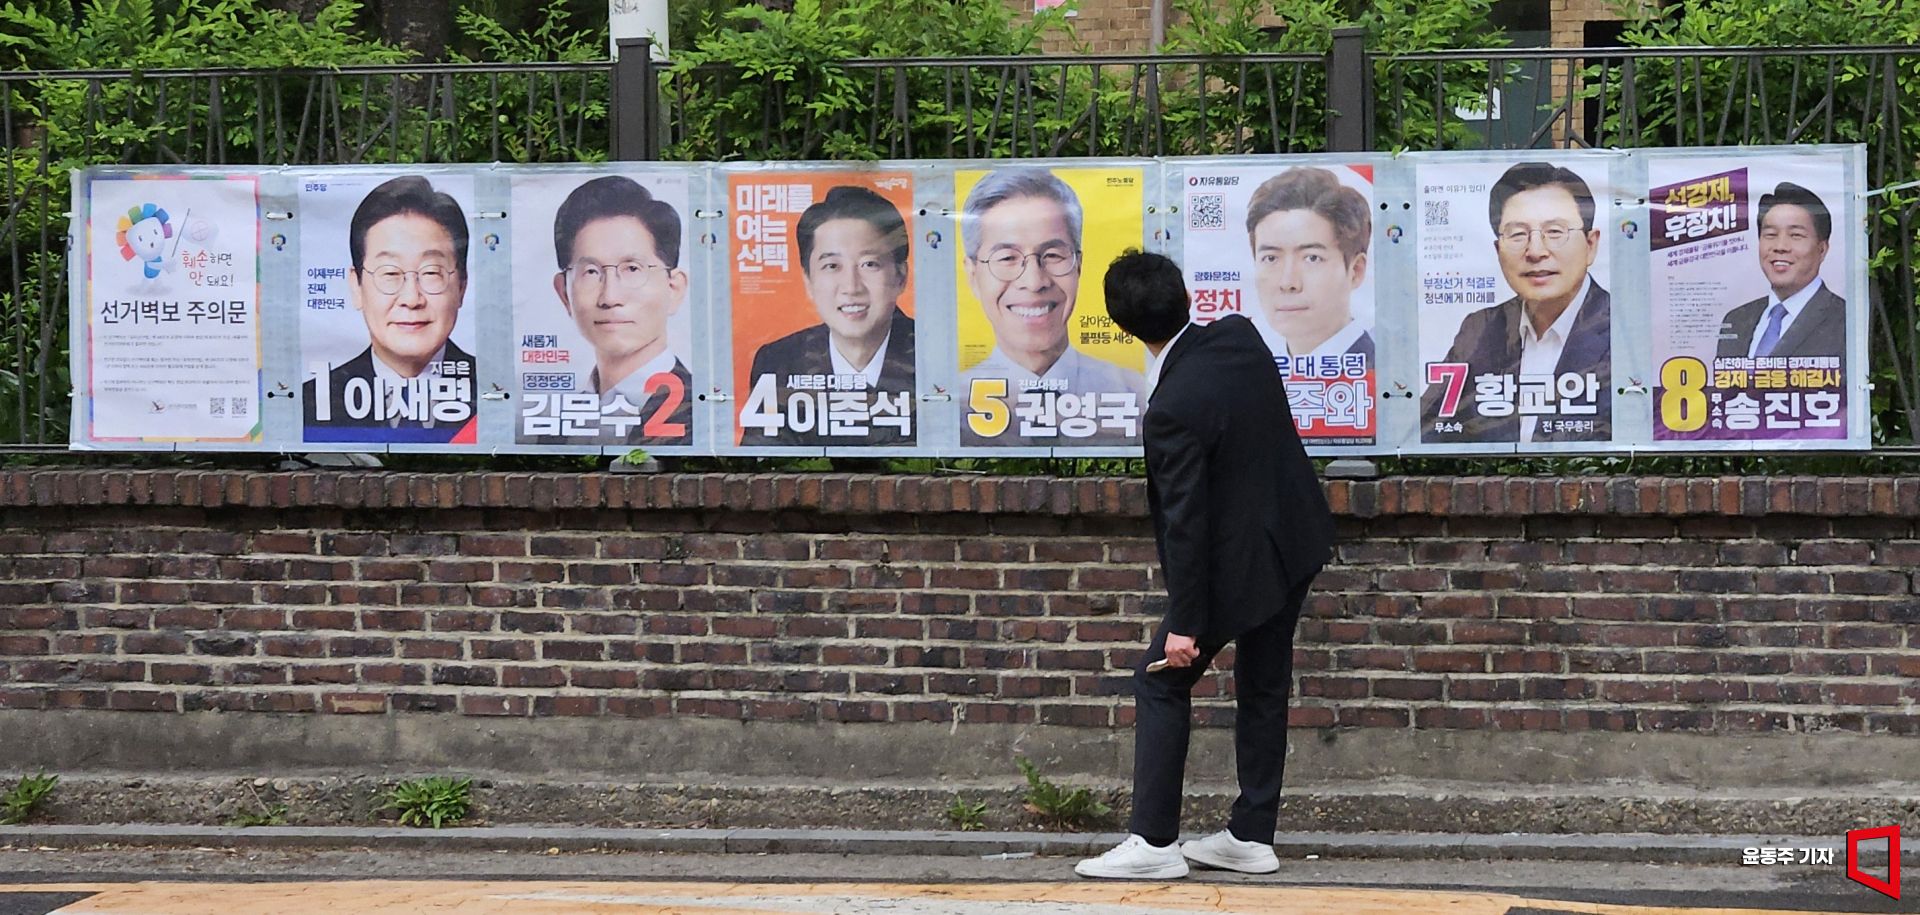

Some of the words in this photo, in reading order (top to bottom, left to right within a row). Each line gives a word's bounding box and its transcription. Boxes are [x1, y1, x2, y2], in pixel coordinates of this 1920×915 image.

[305, 183, 327, 192] 민주당
[1200, 177, 1239, 186] 자유통일당
[1446, 184, 1466, 193] 이유가
[1468, 184, 1486, 193] 있다!
[736, 184, 813, 213] 미래를
[1665, 176, 1735, 213] 선경제,
[736, 214, 787, 242] 여는
[182, 250, 232, 268] 훼손하면
[737, 244, 788, 272] 선택
[189, 271, 203, 286] 안
[207, 274, 234, 287] 돼요!
[307, 267, 345, 279] 이제부터
[1194, 271, 1240, 281] 광화문정신
[307, 283, 326, 295] 진짜
[1424, 277, 1464, 289] 부정선거
[1466, 277, 1496, 289] 척결로
[307, 298, 345, 309] 대한민국
[1195, 289, 1241, 312] 정치
[1424, 292, 1463, 304] 청년에게
[1466, 292, 1496, 304] 미래를
[100, 300, 181, 325] 선거벽보
[186, 300, 247, 325] 주의문
[1079, 315, 1115, 328] 갈아엎
[522, 335, 557, 348] 새롭게
[1080, 332, 1112, 344] 불평등
[1113, 331, 1133, 344] 세상
[522, 350, 570, 363] 대한민국
[1714, 357, 1755, 369] 실천하는
[1755, 357, 1787, 369] 준비된
[1788, 356, 1840, 369] 경제대통령
[431, 361, 470, 375] 지금은
[525, 374, 572, 388] 정정당당
[787, 374, 826, 390] 새로운
[827, 374, 867, 391] 대통령
[1789, 369, 1841, 388] 해결사
[309, 361, 331, 421] 1
[344, 376, 471, 422] 이재명
[1427, 362, 1469, 417] 7
[1475, 372, 1600, 417] 황교안
[1660, 356, 1708, 432] 8
[522, 393, 641, 437] 김문수
[643, 372, 686, 437] 2
[739, 373, 785, 436] 4
[788, 391, 911, 436] 이준석
[967, 379, 1010, 437] 5
[1015, 392, 1140, 437] 권영국
[1724, 391, 1841, 430] 송진호
[1435, 422, 1463, 433] 무소속
[1542, 421, 1553, 432] 전
[1555, 421, 1593, 432] 국무총리
